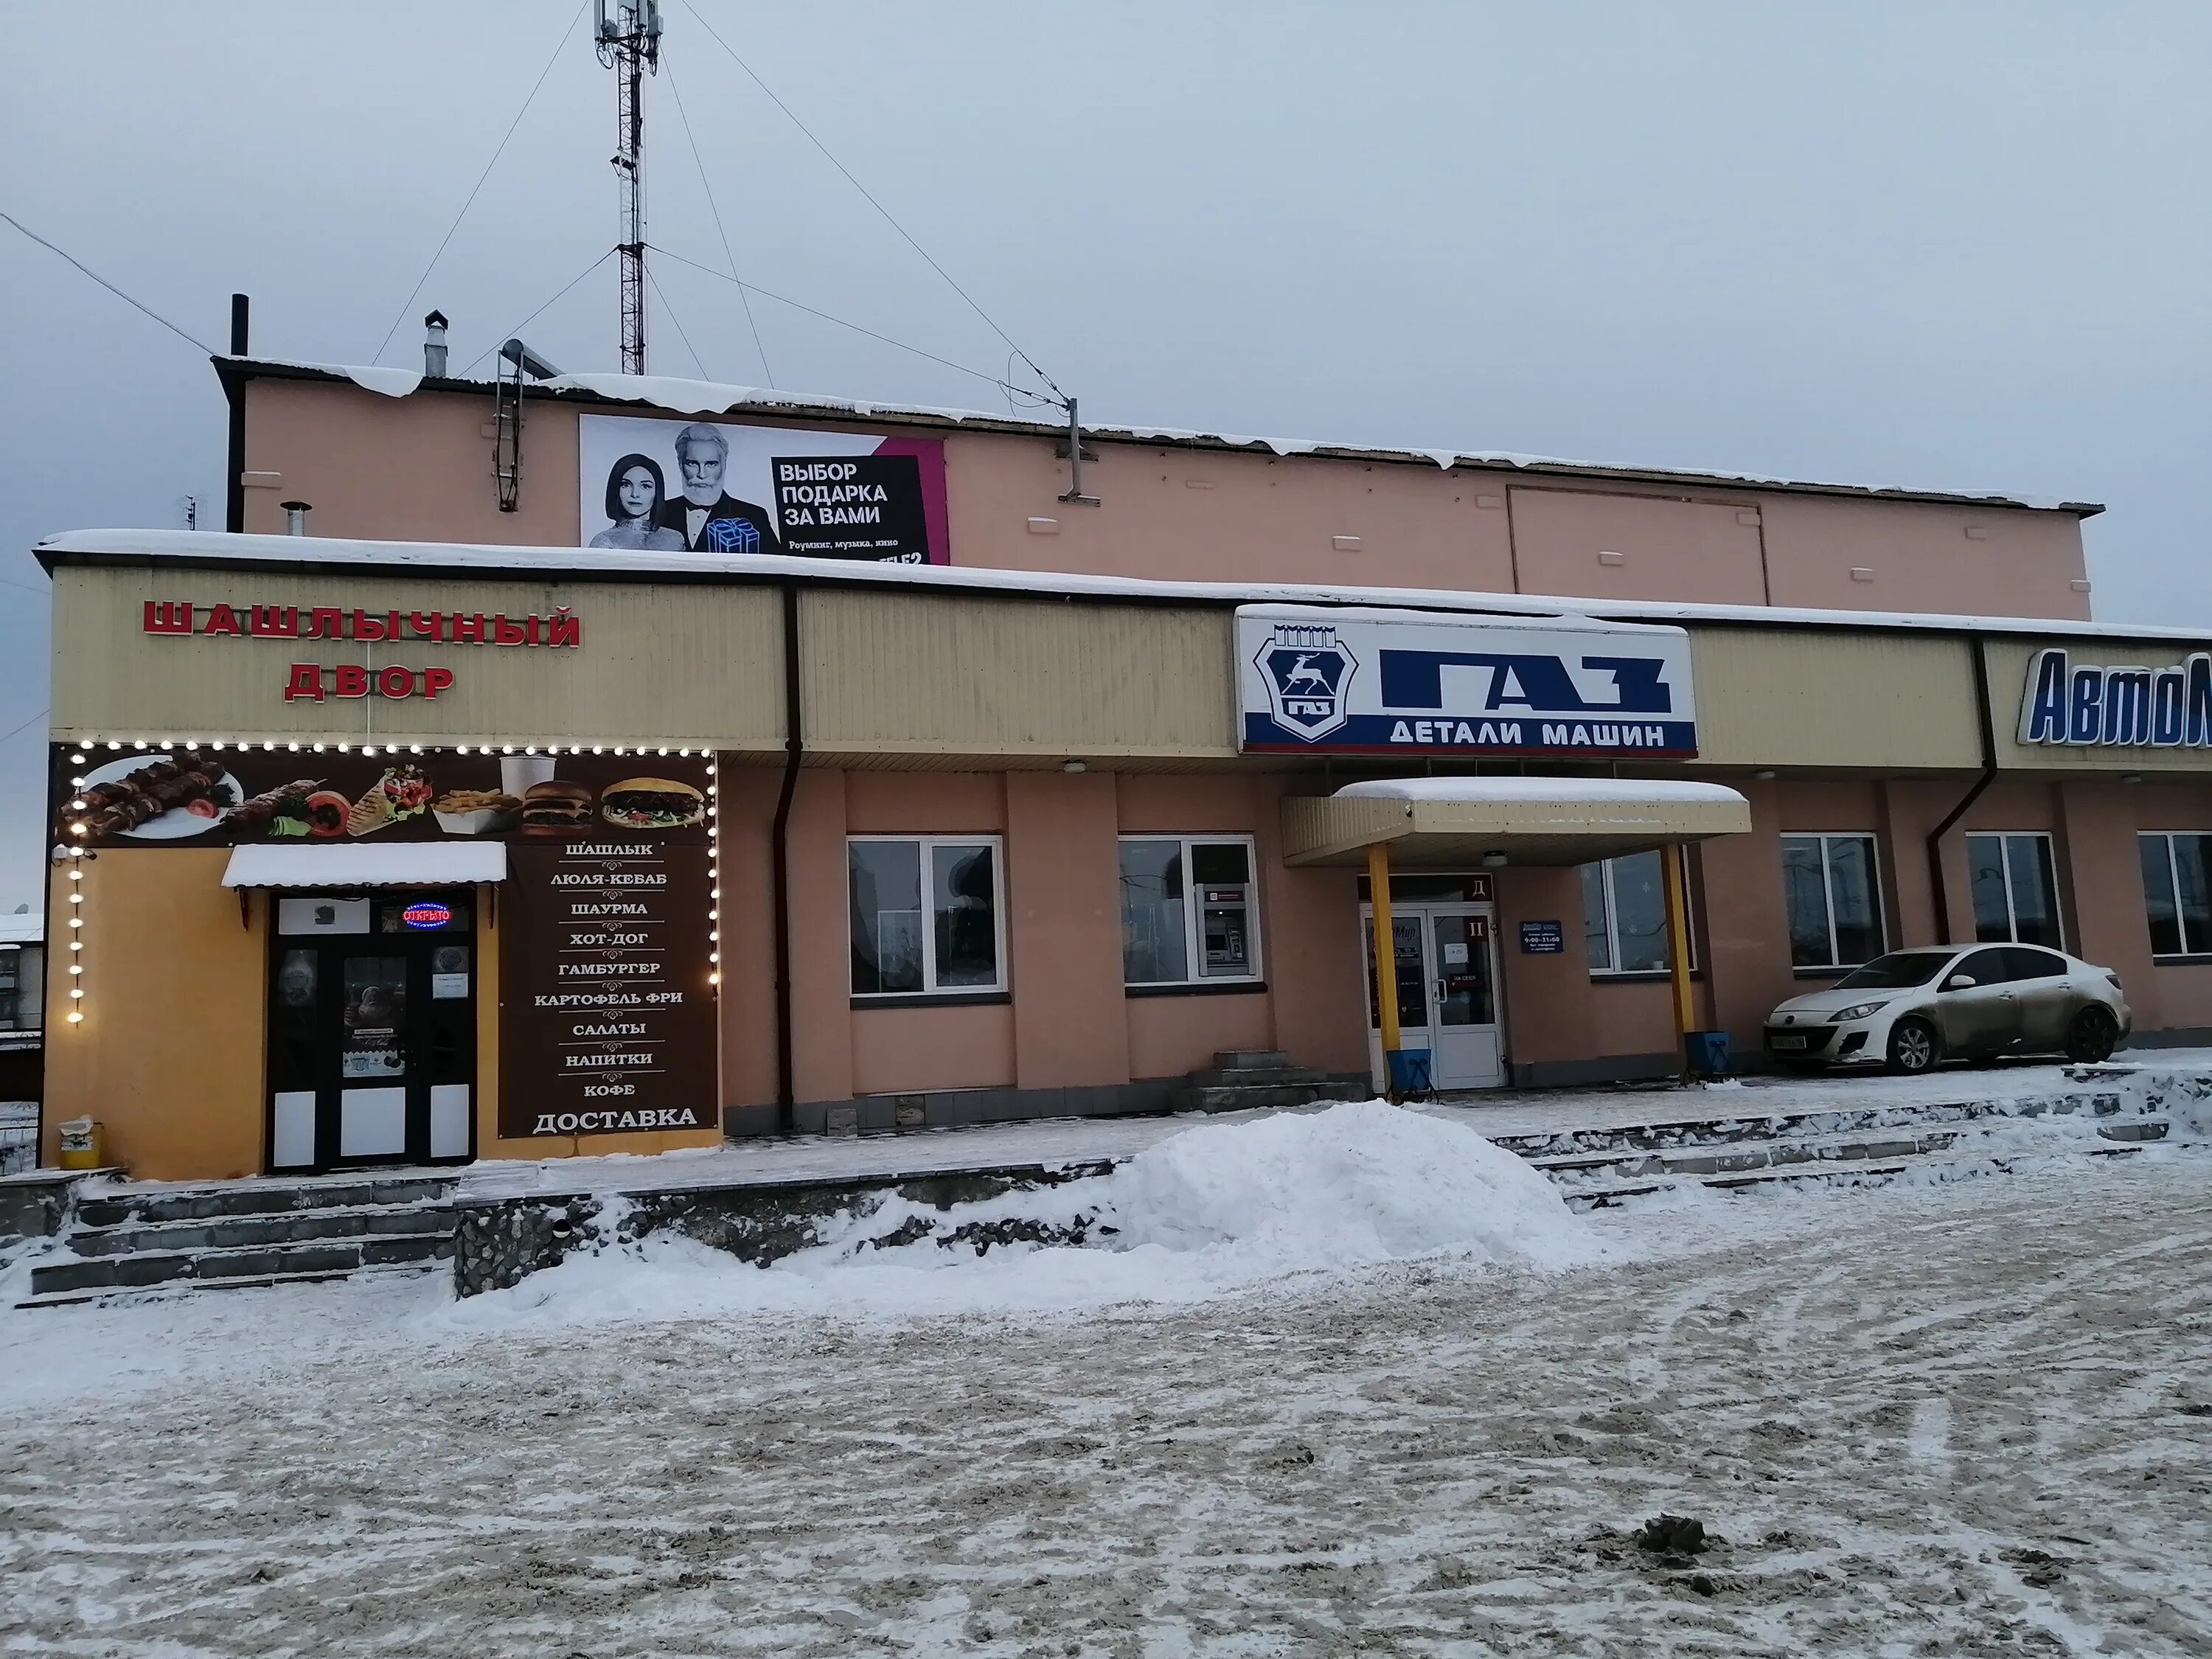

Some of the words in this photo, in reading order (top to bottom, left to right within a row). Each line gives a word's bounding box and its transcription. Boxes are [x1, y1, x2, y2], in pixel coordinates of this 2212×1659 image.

[779, 463, 857, 481] ВЫБОР
[782, 484, 888, 506] ПОДАРКА
[785, 508, 815, 526] ЗА
[819, 507, 880, 525] ВАМИ
[789, 540, 832, 552] Роуминг,
[835, 540, 873, 550] музыка,
[143, 599, 580, 647] ШАШЛЫЧНЫЙ
[284, 662, 454, 703] ДВОР
[1380, 650, 1672, 713] ГАЗ
[1288, 701, 1331, 715] ГАЗ
[1390, 720, 1522, 744] ДЕТАЛИ
[1542, 723, 1665, 747] МАШИН
[566, 844, 653, 855] ШАШЛЫК
[550, 874, 667, 885] ЛЮЛЯ-КЕБАБ
[403, 909, 451, 922] ОТКРЫТО
[571, 903, 648, 914] ШАУРМА
[569, 933, 649, 946] ХОТ-ДОГ
[558, 963, 661, 975] ГАМБУРГЕР
[535, 993, 641, 1006] КАРТОФЕЛЬ
[645, 992, 684, 1004] ФРИ
[572, 1023, 646, 1036] САЛАТЫ
[566, 1053, 653, 1067] НАПИТКИ
[584, 1084, 636, 1096] КОФЕ
[532, 1107, 698, 1134] ДОСТАВКА
